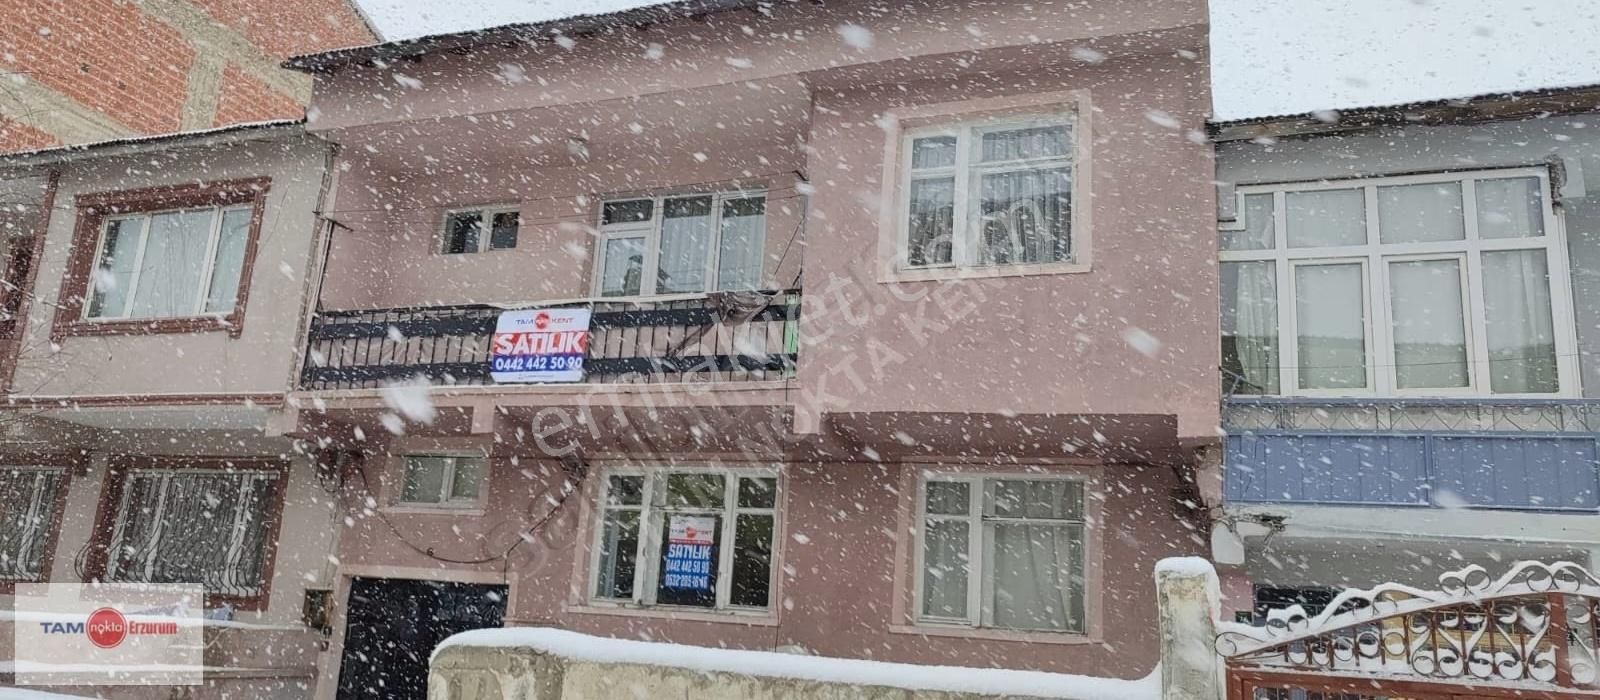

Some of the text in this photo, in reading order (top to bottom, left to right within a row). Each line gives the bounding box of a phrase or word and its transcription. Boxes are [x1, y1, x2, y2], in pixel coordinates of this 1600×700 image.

[495, 355, 583, 371] 0442 442 50 90
